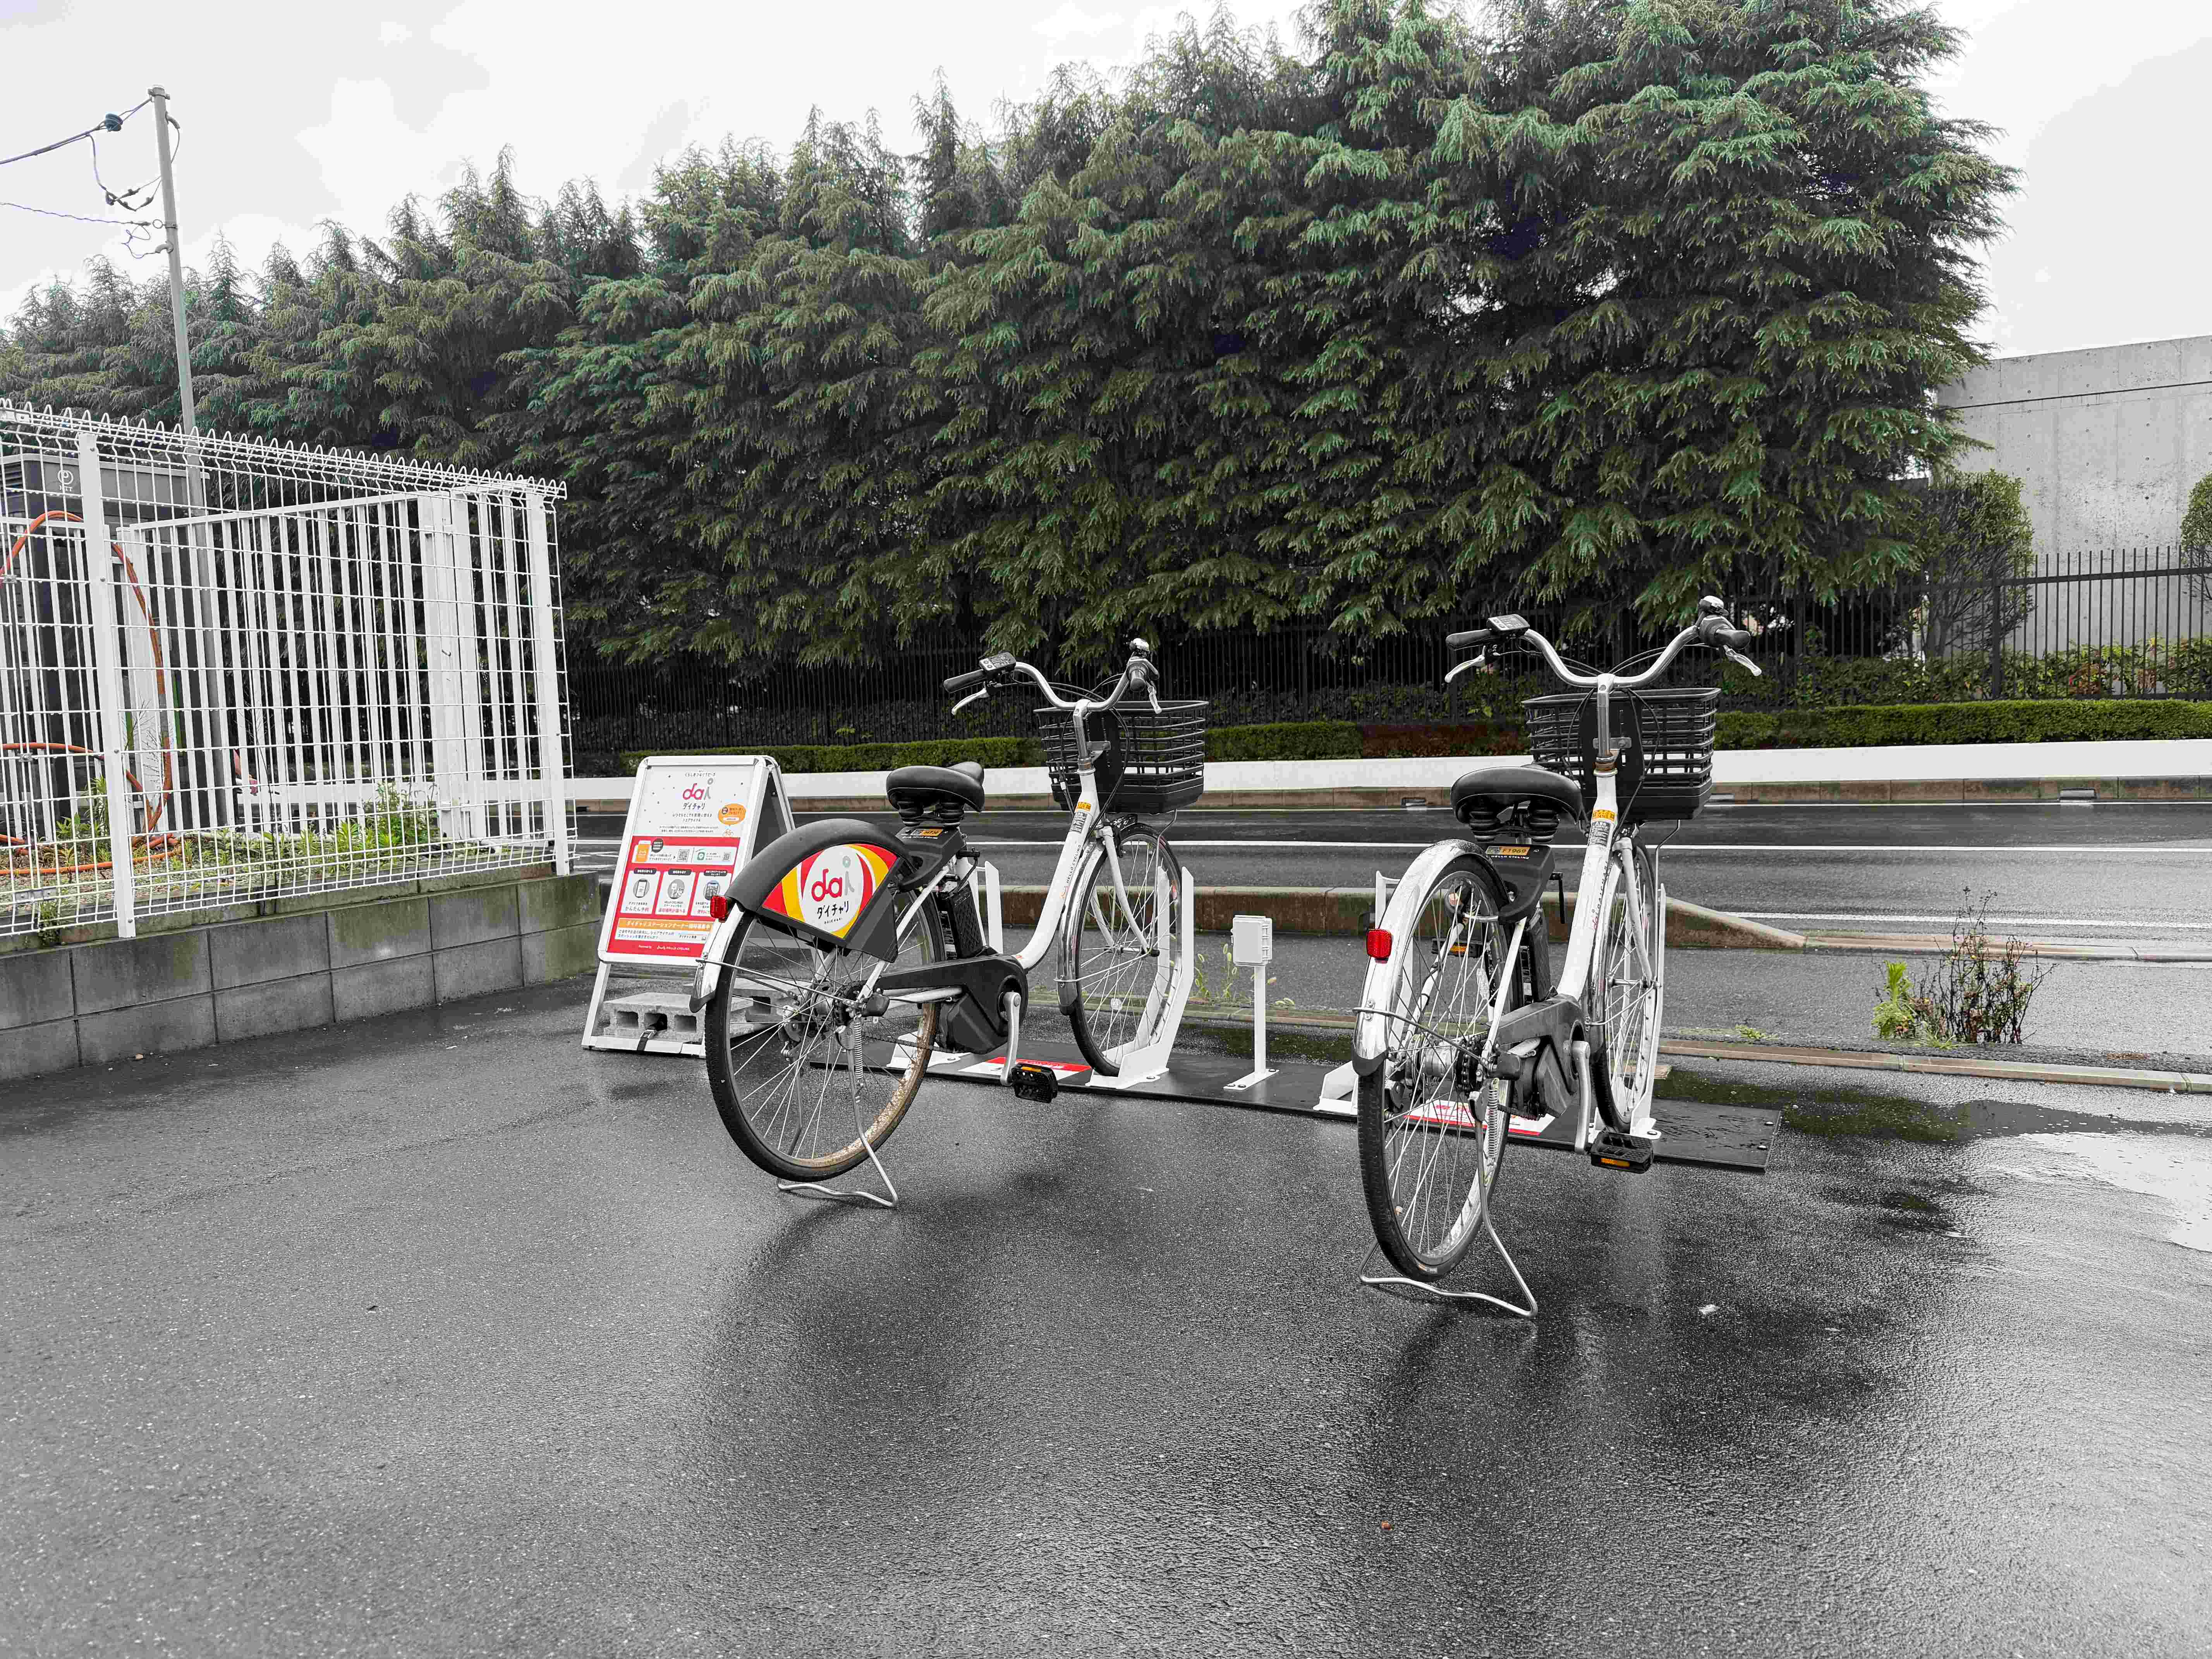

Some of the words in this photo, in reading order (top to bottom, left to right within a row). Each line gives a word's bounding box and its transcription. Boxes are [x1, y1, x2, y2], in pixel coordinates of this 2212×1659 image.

[682, 778, 713, 800] dai
[811, 855, 855, 902] dai
[817, 901, 849, 919] ダイチャリ
